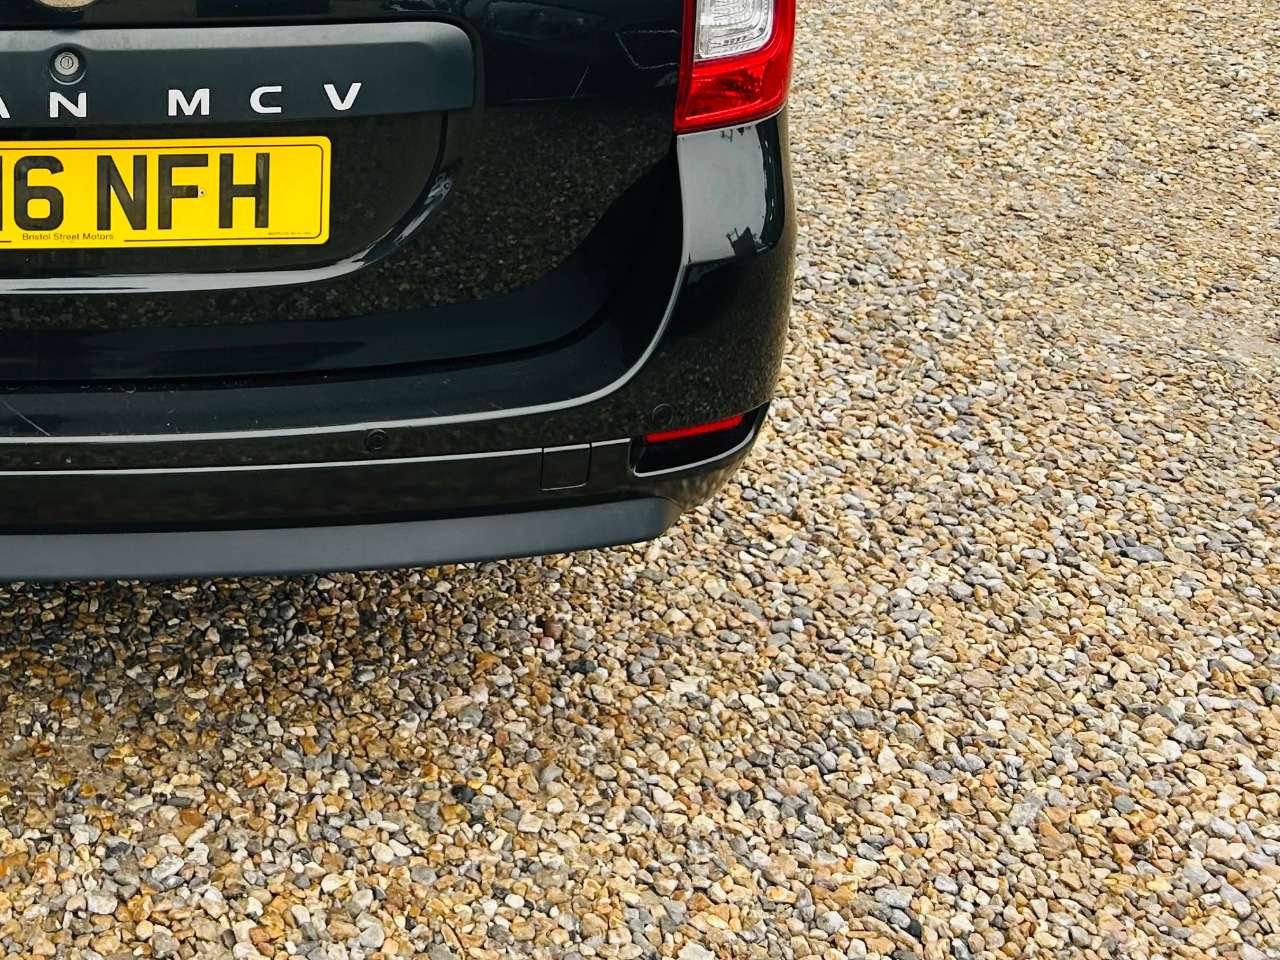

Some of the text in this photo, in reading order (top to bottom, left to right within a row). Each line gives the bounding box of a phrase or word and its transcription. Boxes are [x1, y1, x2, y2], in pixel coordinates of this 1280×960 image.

[167, 82, 363, 117] MCV
[96, 152, 271, 231] NFH
[22, 232, 115, 241] Bristol Street Motors
